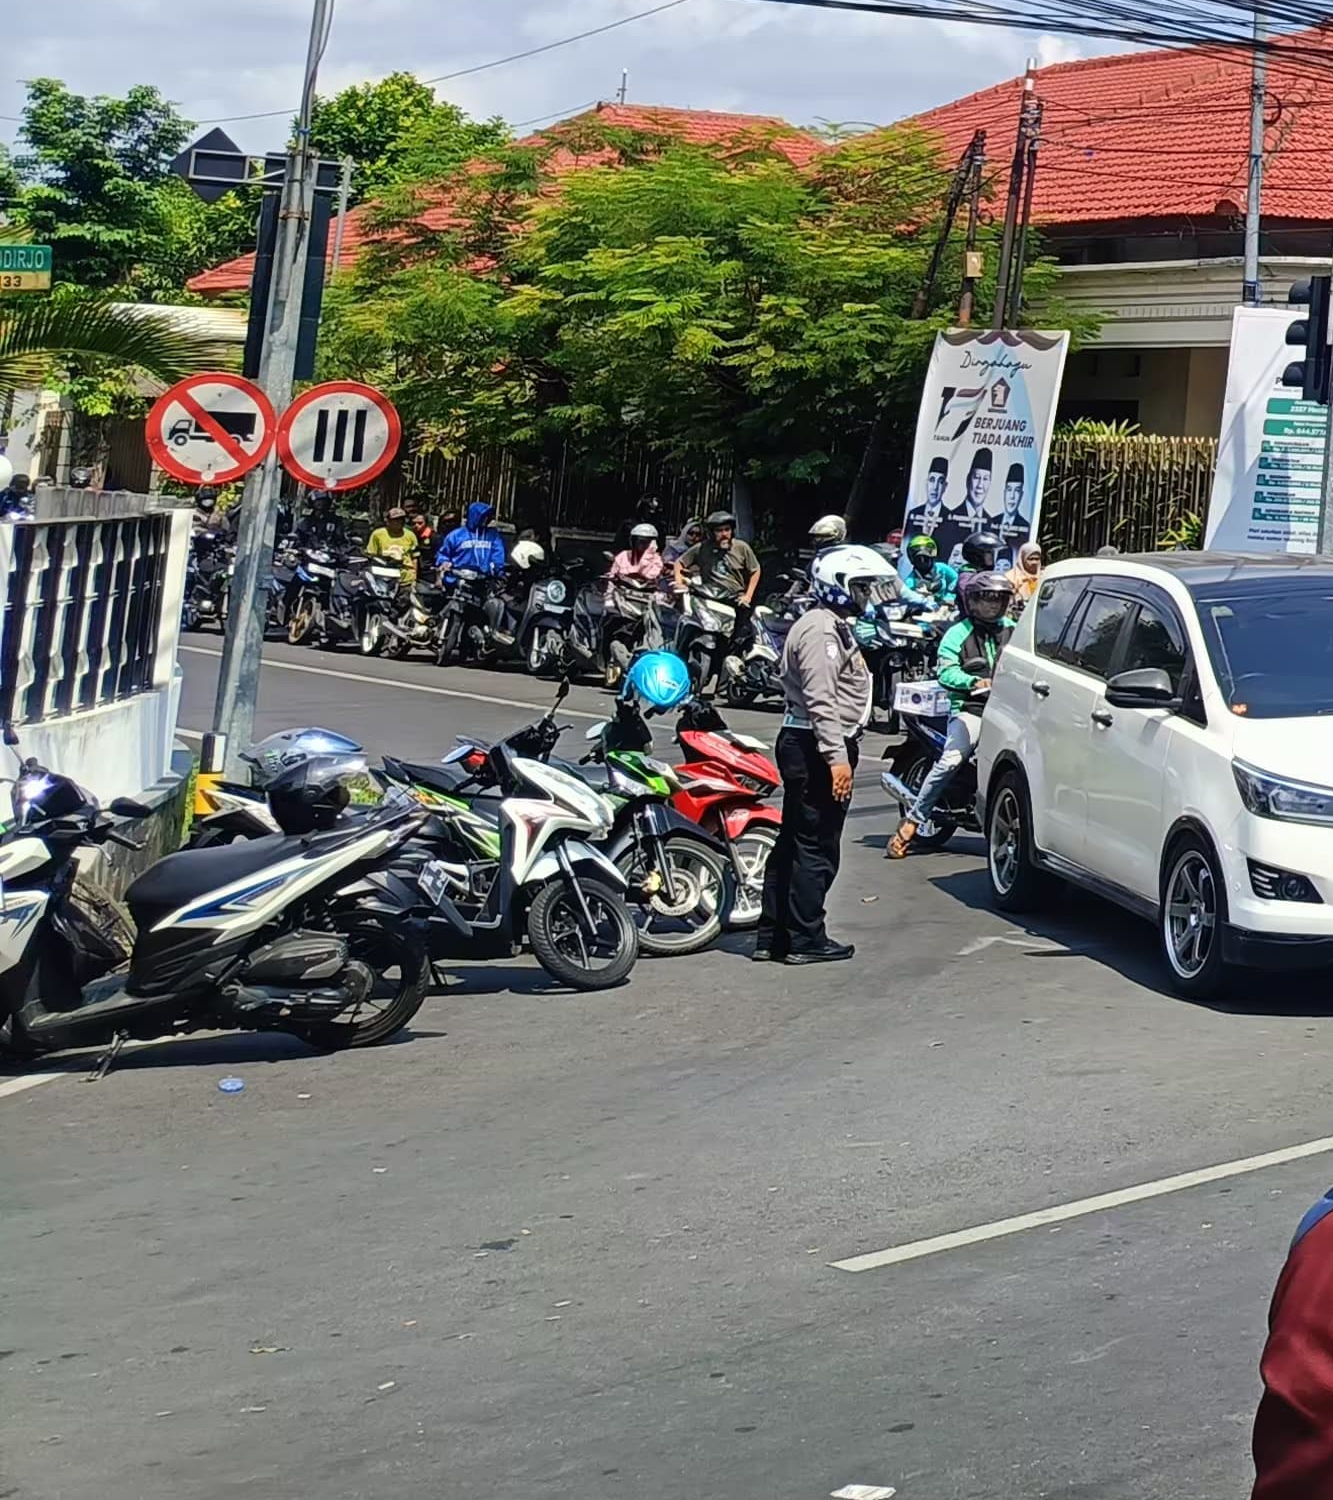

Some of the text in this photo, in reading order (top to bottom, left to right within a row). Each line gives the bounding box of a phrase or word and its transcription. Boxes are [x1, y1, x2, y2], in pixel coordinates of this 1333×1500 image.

[0, 250, 44, 269] DIRJO
[974, 417, 1027, 432] BERJUANG
[971, 432, 1035, 449] TIADA AKHIR
